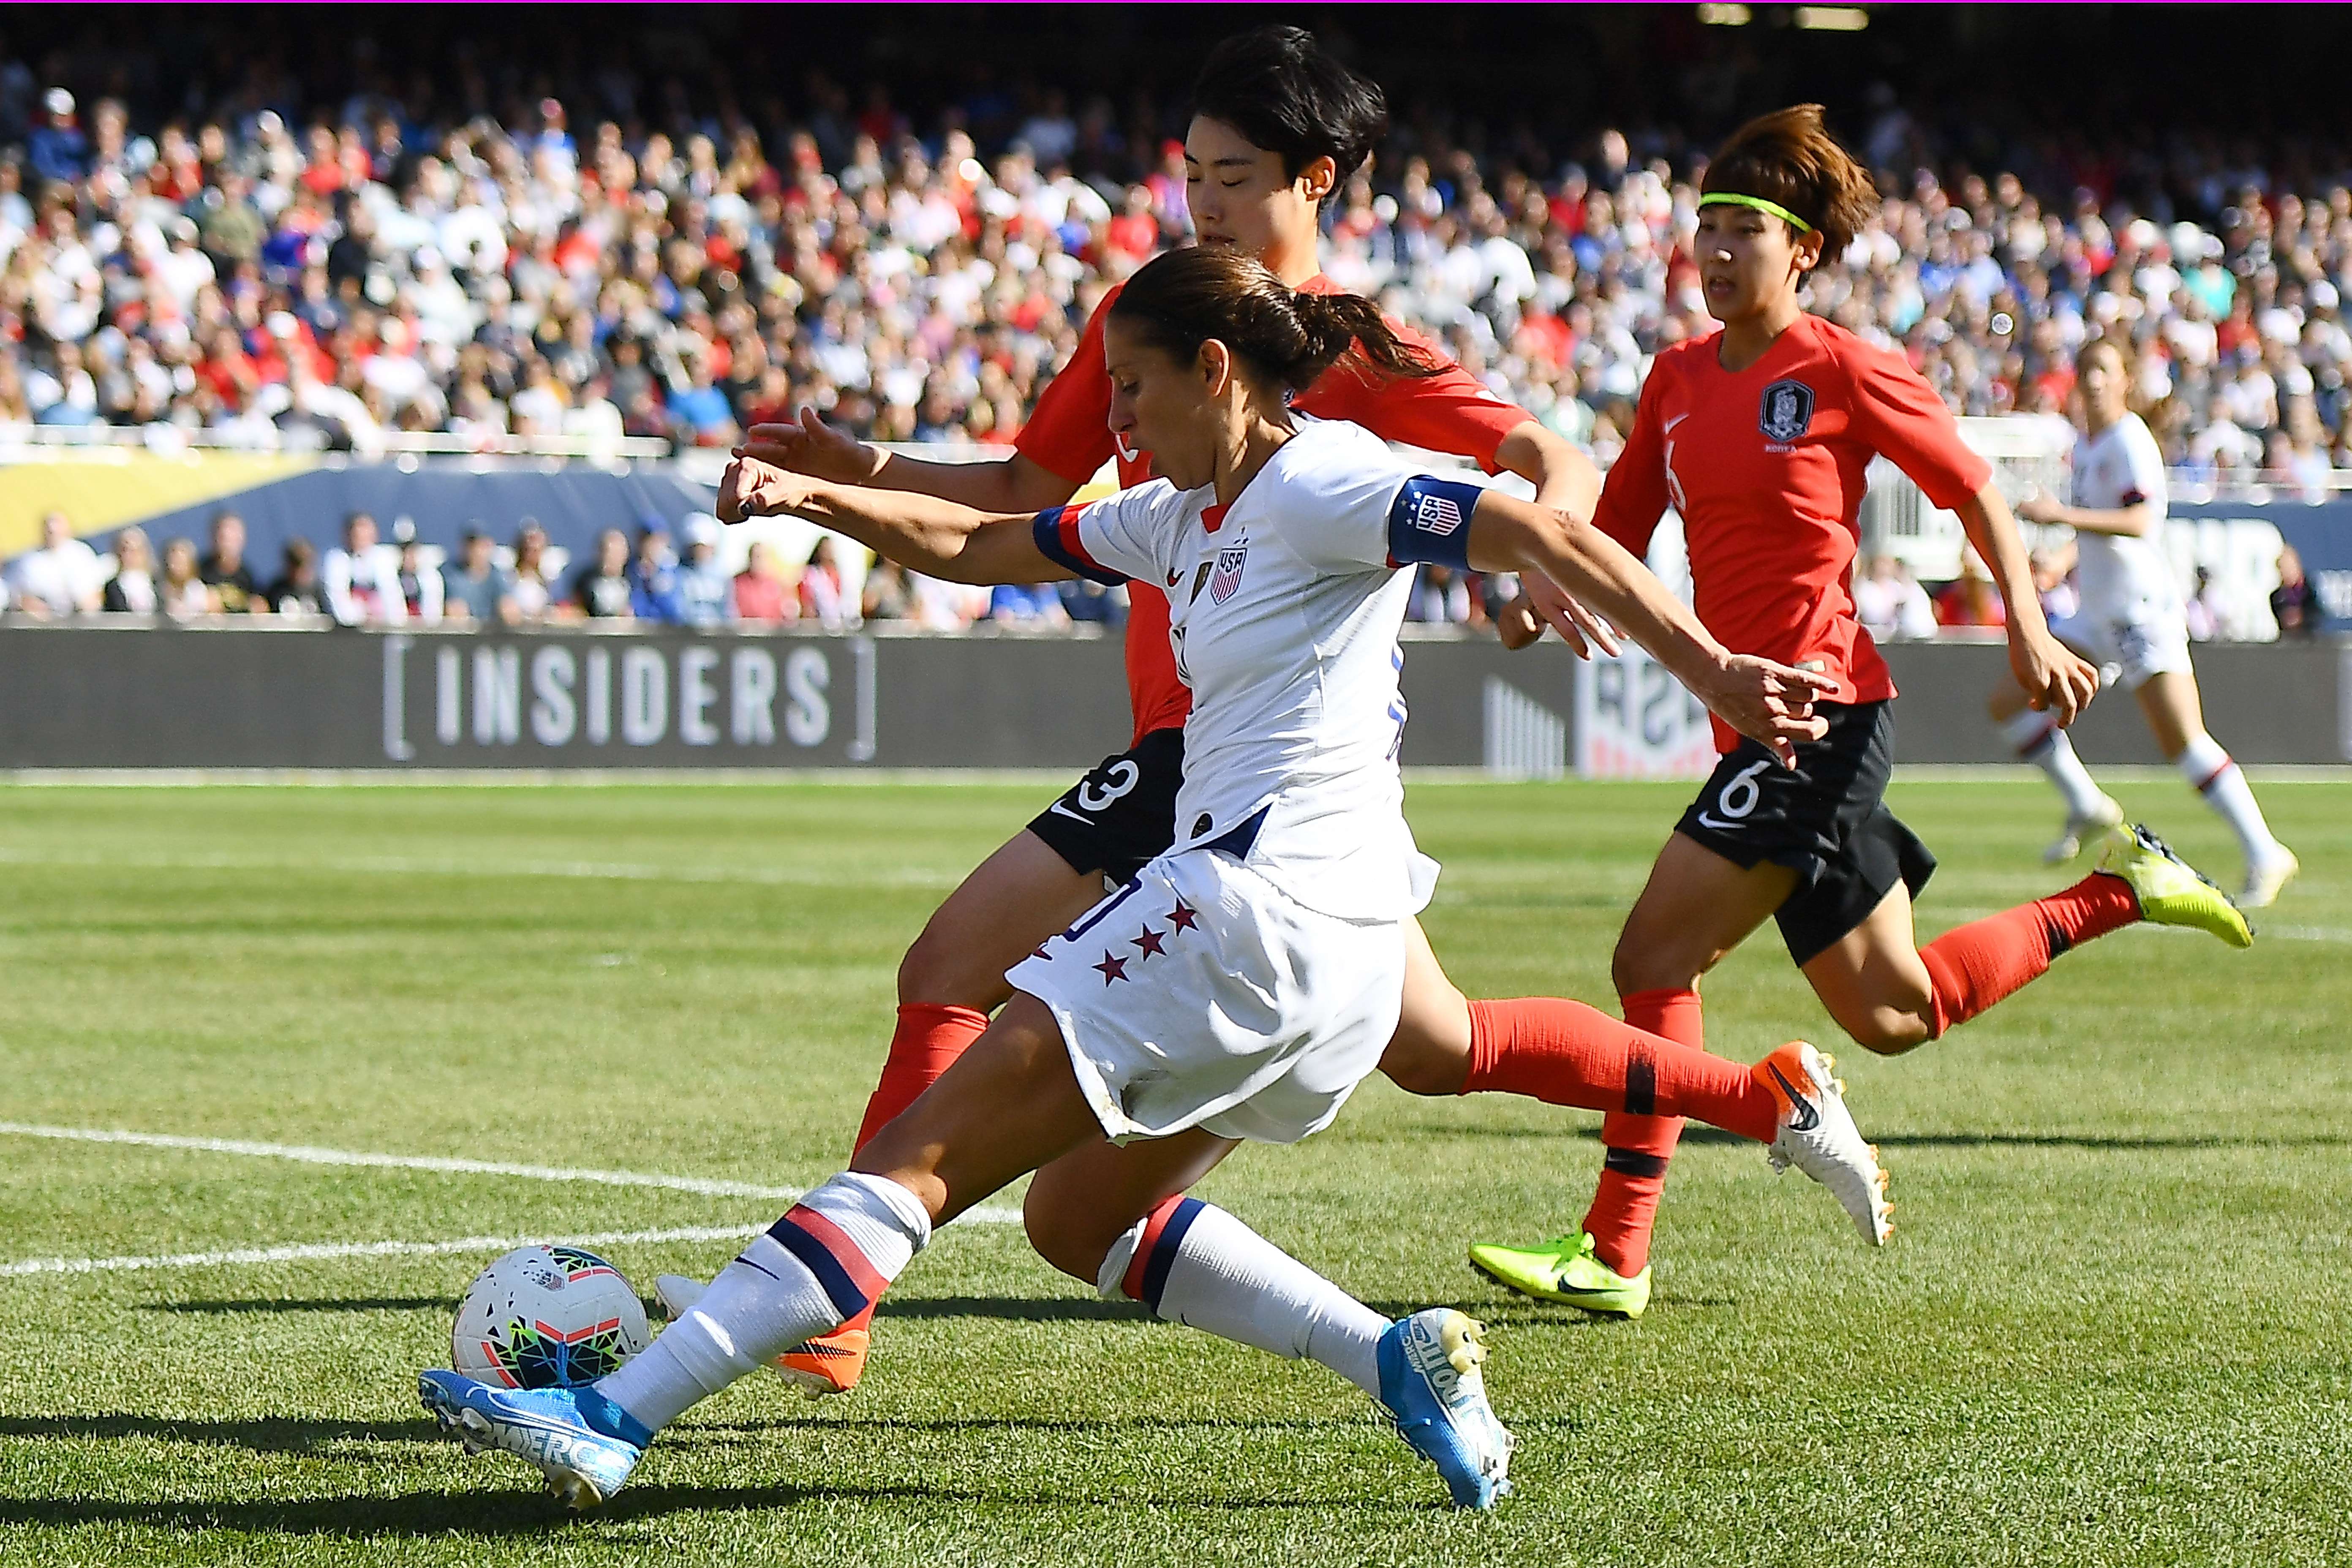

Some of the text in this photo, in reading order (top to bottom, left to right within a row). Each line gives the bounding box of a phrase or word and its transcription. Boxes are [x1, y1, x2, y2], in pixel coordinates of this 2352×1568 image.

[1418, 498, 1438, 528] USA
[1220, 552, 1244, 573] USA
[435, 645, 831, 747] INSIDERS
[1078, 760, 1139, 811] 3
[1720, 760, 1771, 818] 6
[538, 1272, 552, 1285] USA
